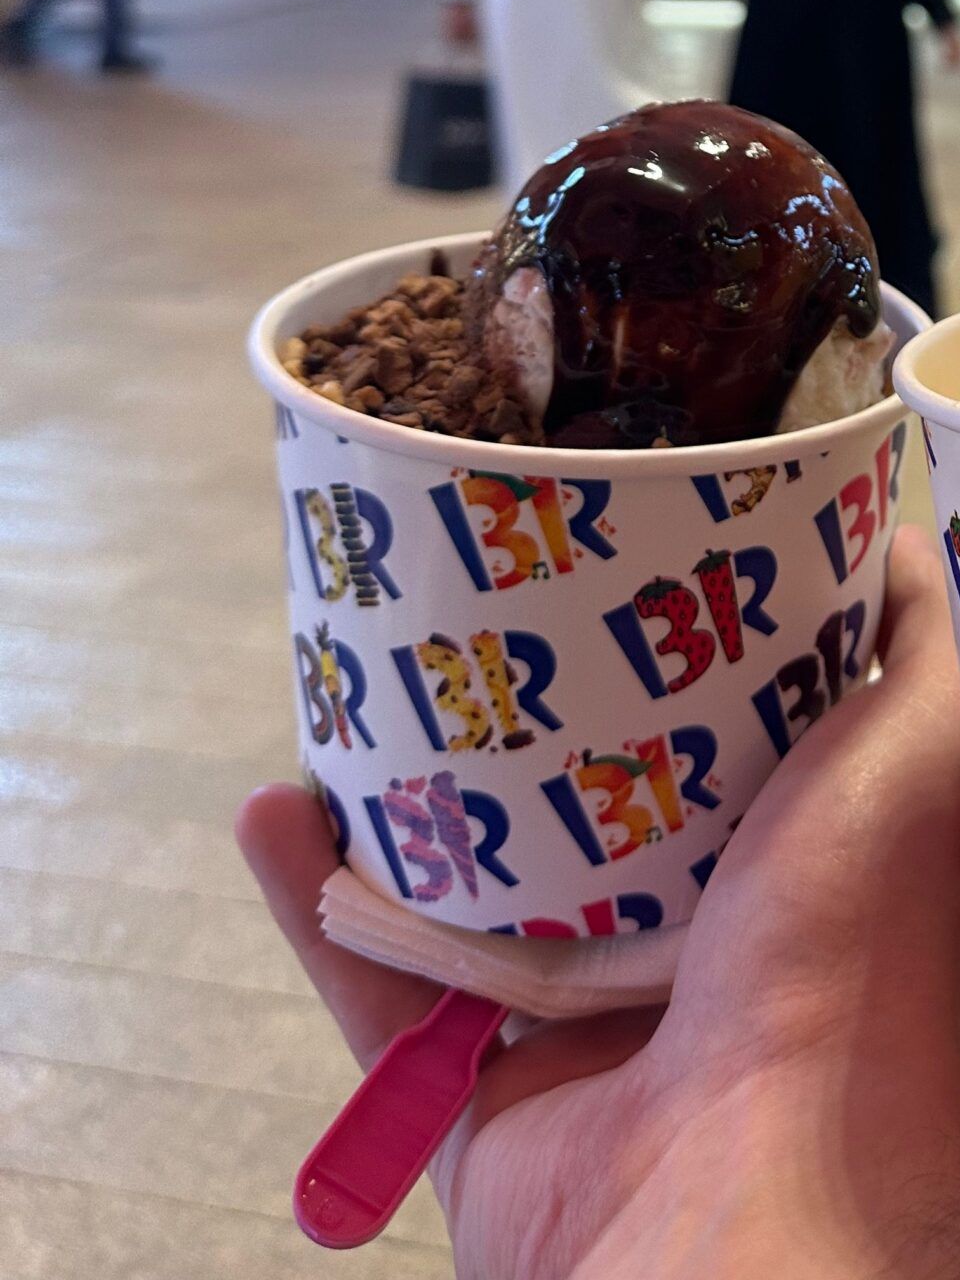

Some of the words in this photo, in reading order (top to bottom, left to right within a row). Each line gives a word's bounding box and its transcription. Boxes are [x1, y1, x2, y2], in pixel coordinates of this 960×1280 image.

[294, 482, 403, 607] BR
[428, 468, 618, 592] BR
[294, 619, 377, 751] BR
[602, 548, 779, 699] BR
[751, 599, 866, 760] BR
[391, 630, 564, 754] BR
[363, 770, 520, 902] BR
[540, 724, 723, 867] BR
